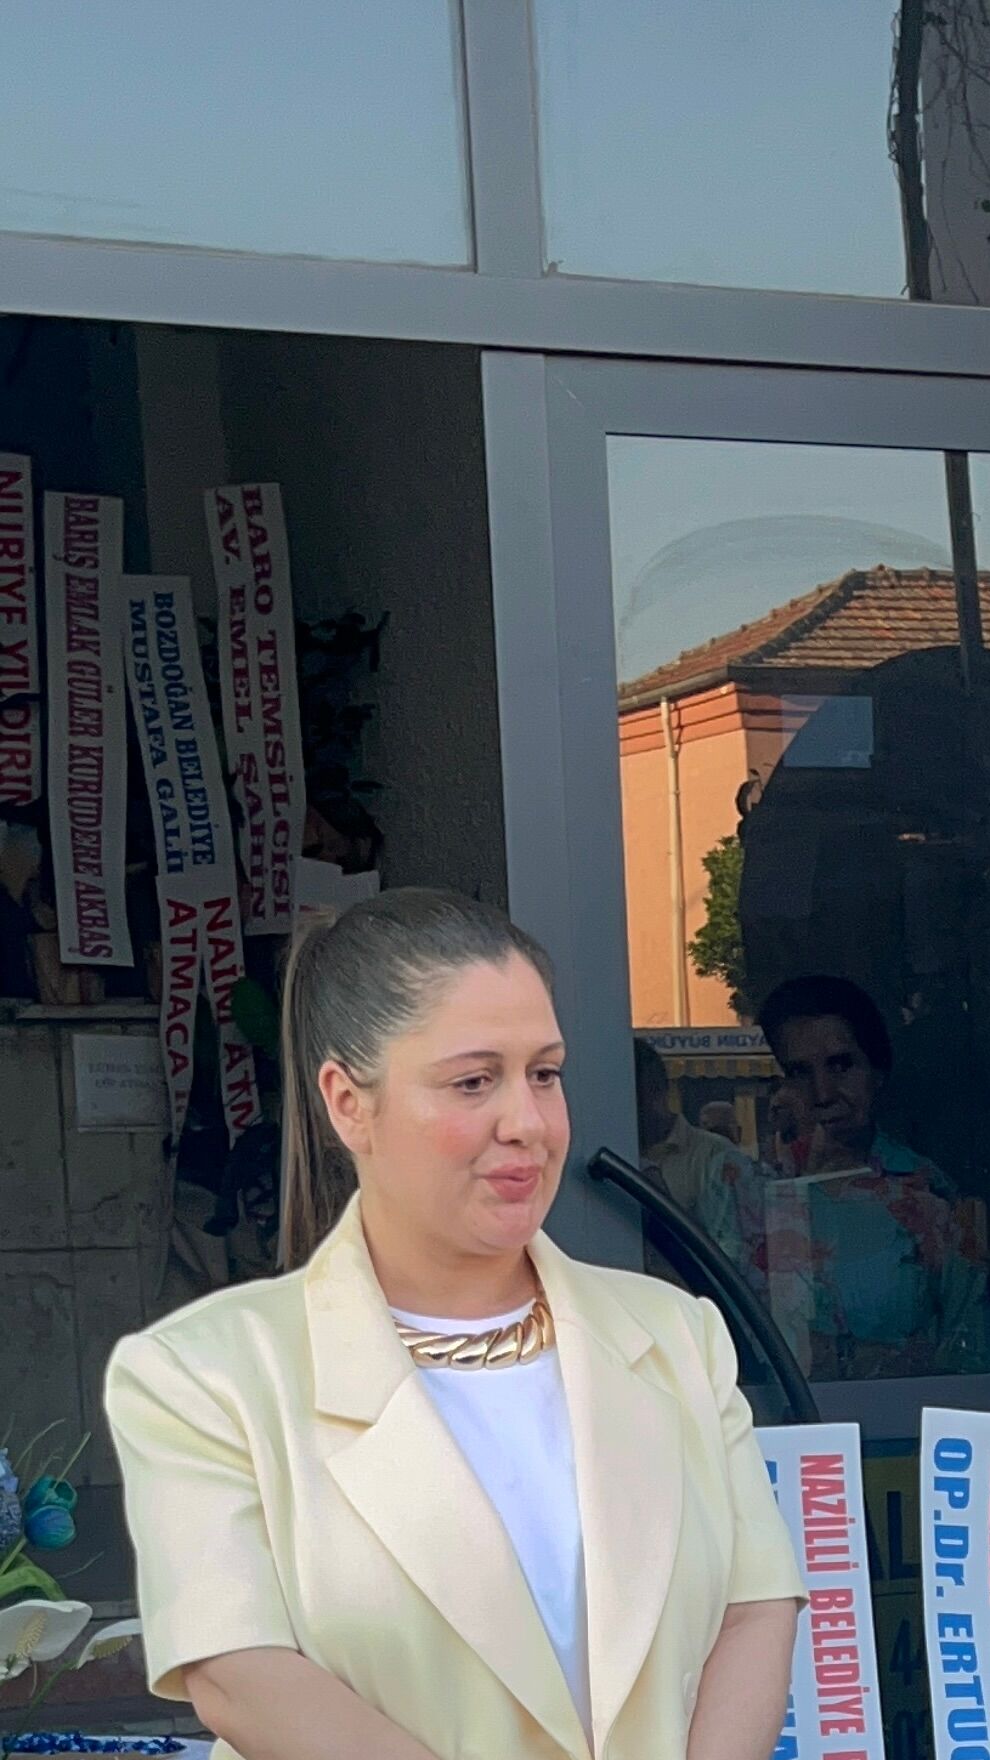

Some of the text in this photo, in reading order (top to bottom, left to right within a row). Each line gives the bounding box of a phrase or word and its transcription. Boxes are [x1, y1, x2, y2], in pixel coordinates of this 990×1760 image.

[53, 496, 99, 568] BARIŞ
[66, 574, 100, 656] EMLAK
[129, 599, 168, 768] MUSTAFA
[229, 584, 251, 733] EMEL
[68, 661, 113, 737] GÜLER
[153, 591, 218, 864] BOZDOĞAN BELEDİYE
[241, 486, 295, 916] BARO TEMSİLCİSİ
[165, 899, 198, 1078] ATMACA
[800, 1454, 859, 1572] NAZİLLİ
[933, 1437, 973, 1598] OP.Dr.
[809, 1588, 870, 1737] BELEDİYE
